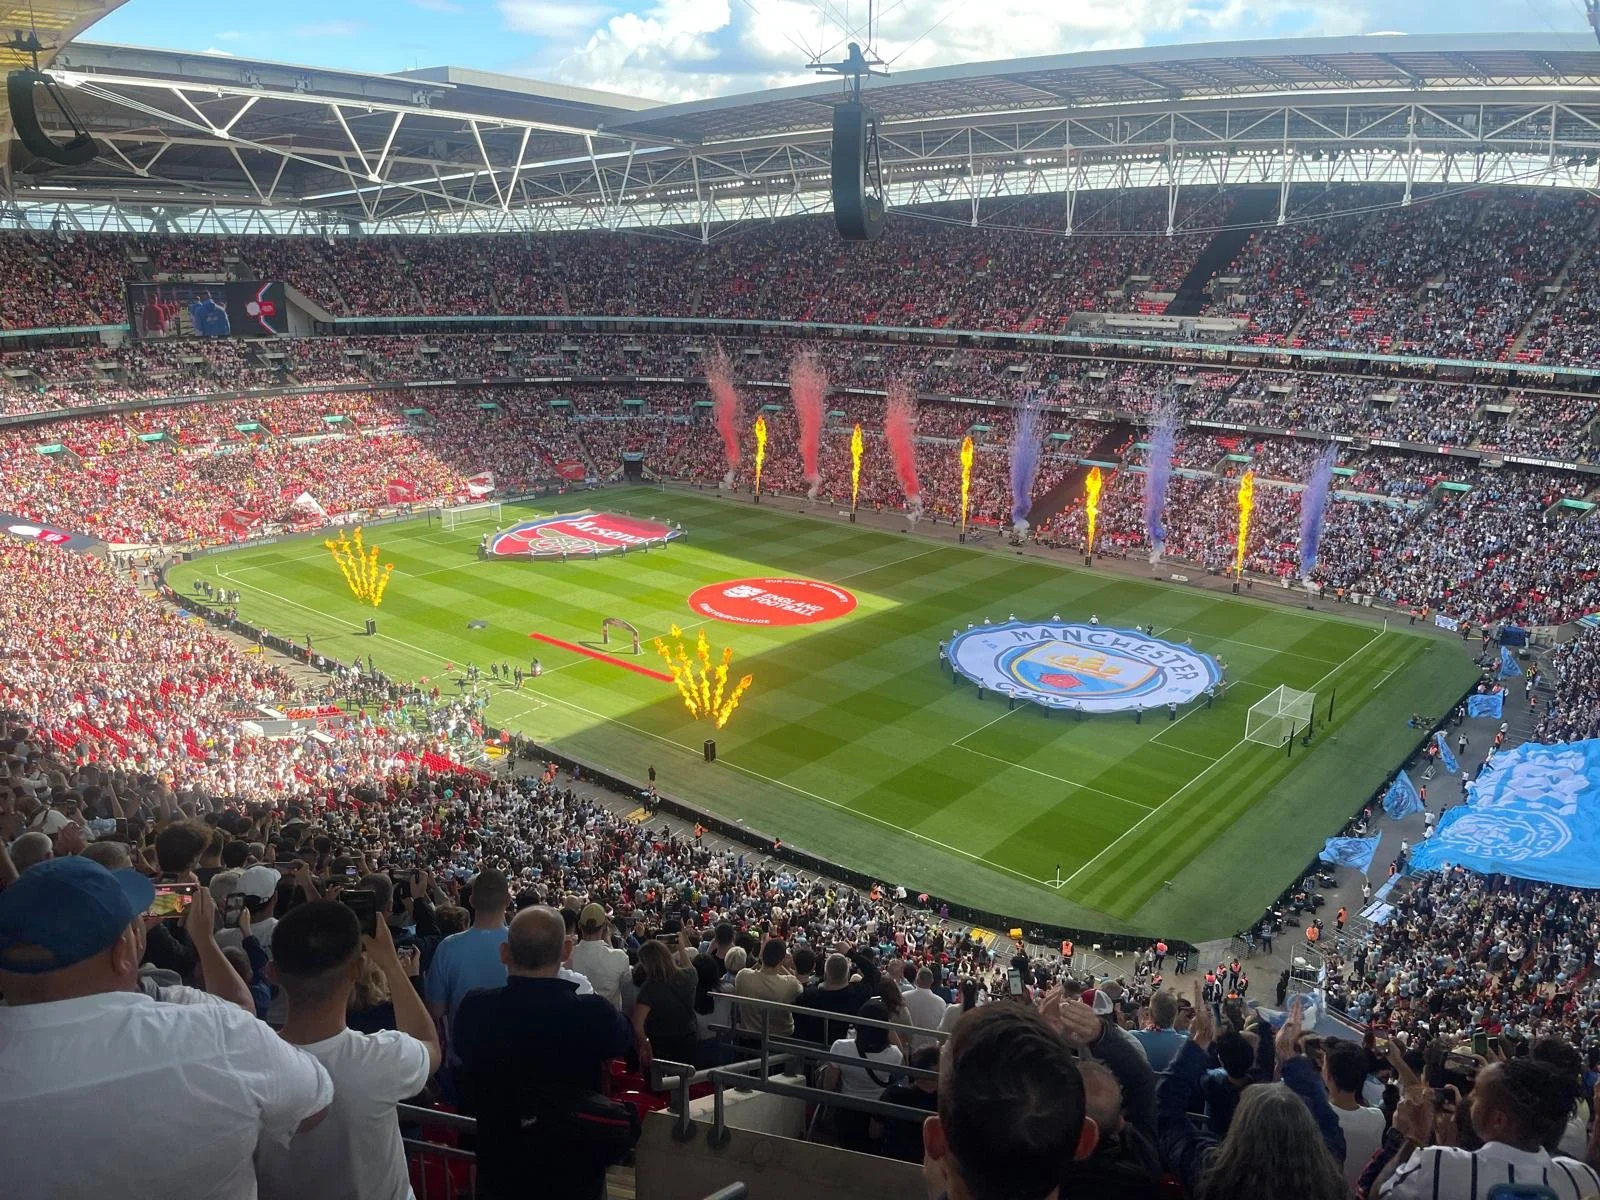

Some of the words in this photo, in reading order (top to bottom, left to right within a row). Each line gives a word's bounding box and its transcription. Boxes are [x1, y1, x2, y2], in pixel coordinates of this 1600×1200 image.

[750, 596, 815, 617] FOOTBALL
[761, 593, 825, 612] ENGLAND
[1011, 627, 1200, 681] MANCHESTER
